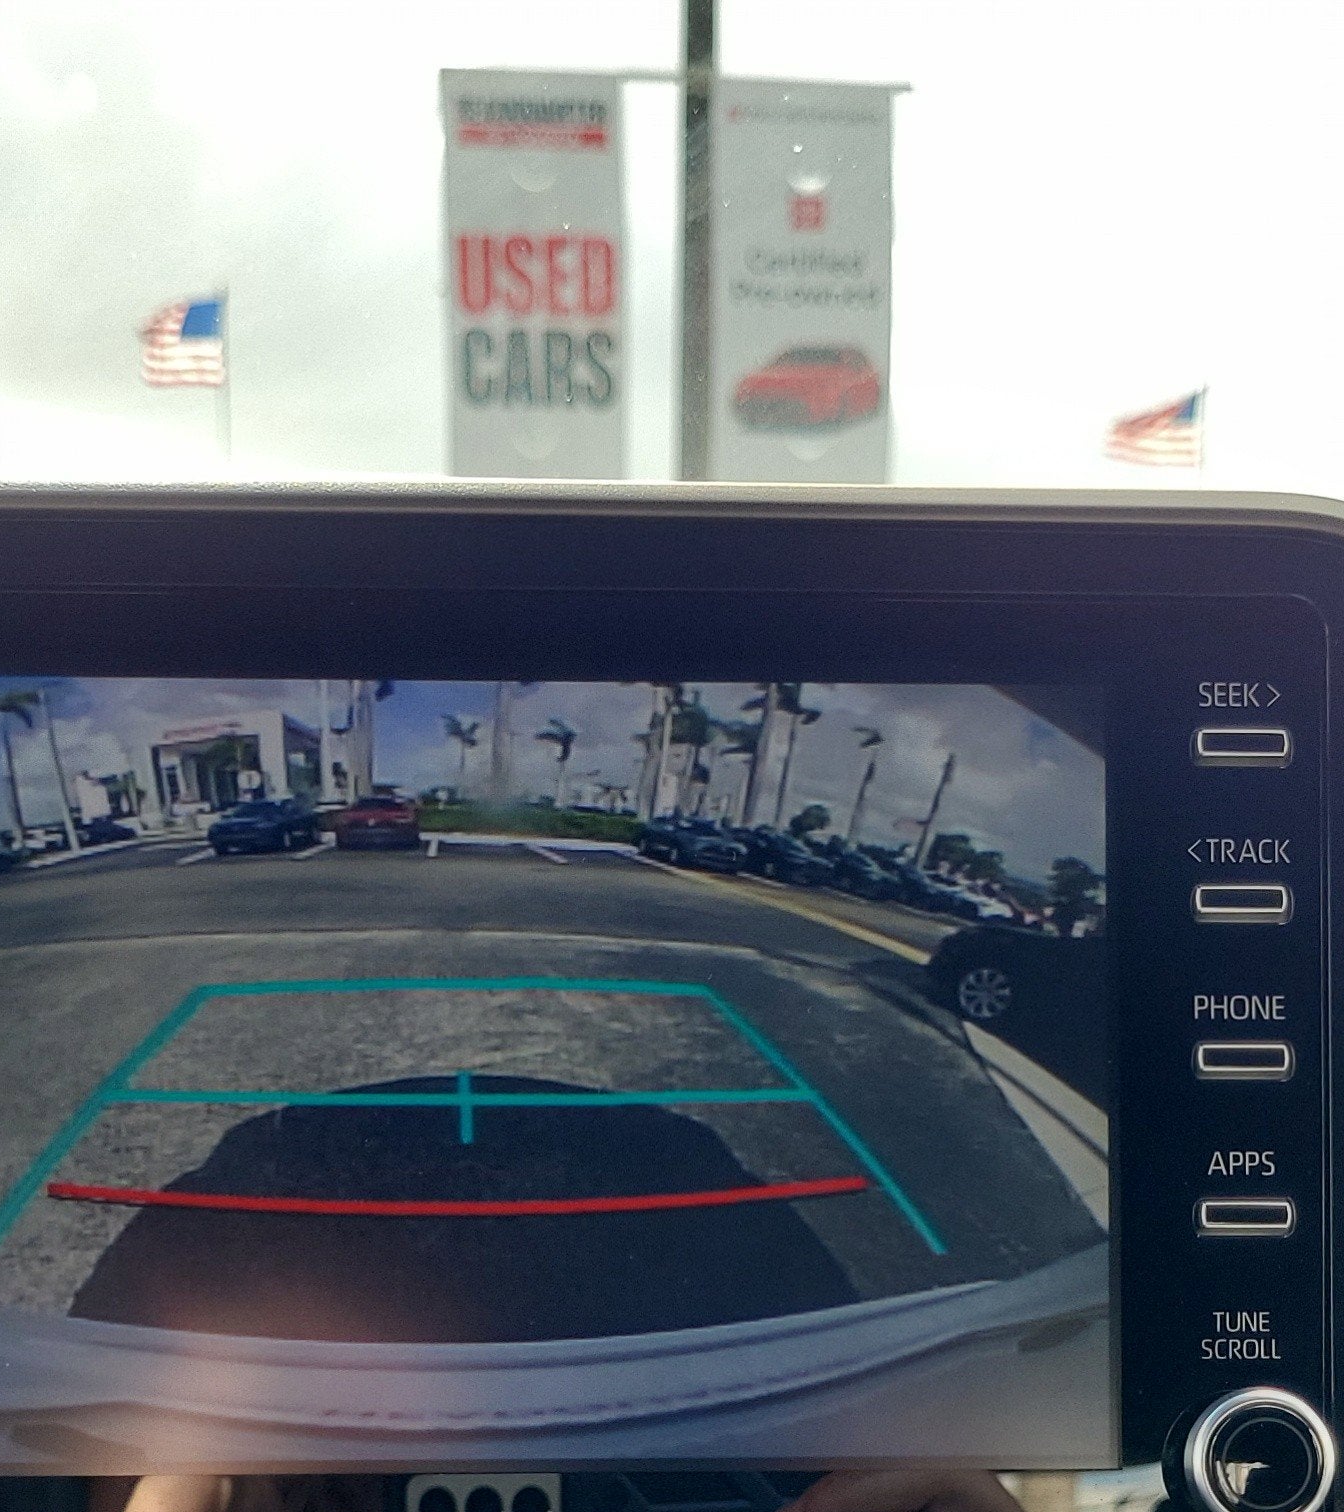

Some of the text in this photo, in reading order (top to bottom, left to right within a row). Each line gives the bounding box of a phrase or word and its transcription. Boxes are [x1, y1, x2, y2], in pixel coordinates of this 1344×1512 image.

[457, 234, 616, 319] USED
[461, 327, 616, 411] CARS
[1197, 681, 1261, 708] SEEK
[1205, 838, 1291, 864] TRACK
[1192, 995, 1287, 1021] PHONE
[1207, 1150, 1276, 1177] APPS
[1212, 1311, 1271, 1333] TUNE
[1201, 1338, 1282, 1361] SCROLL
